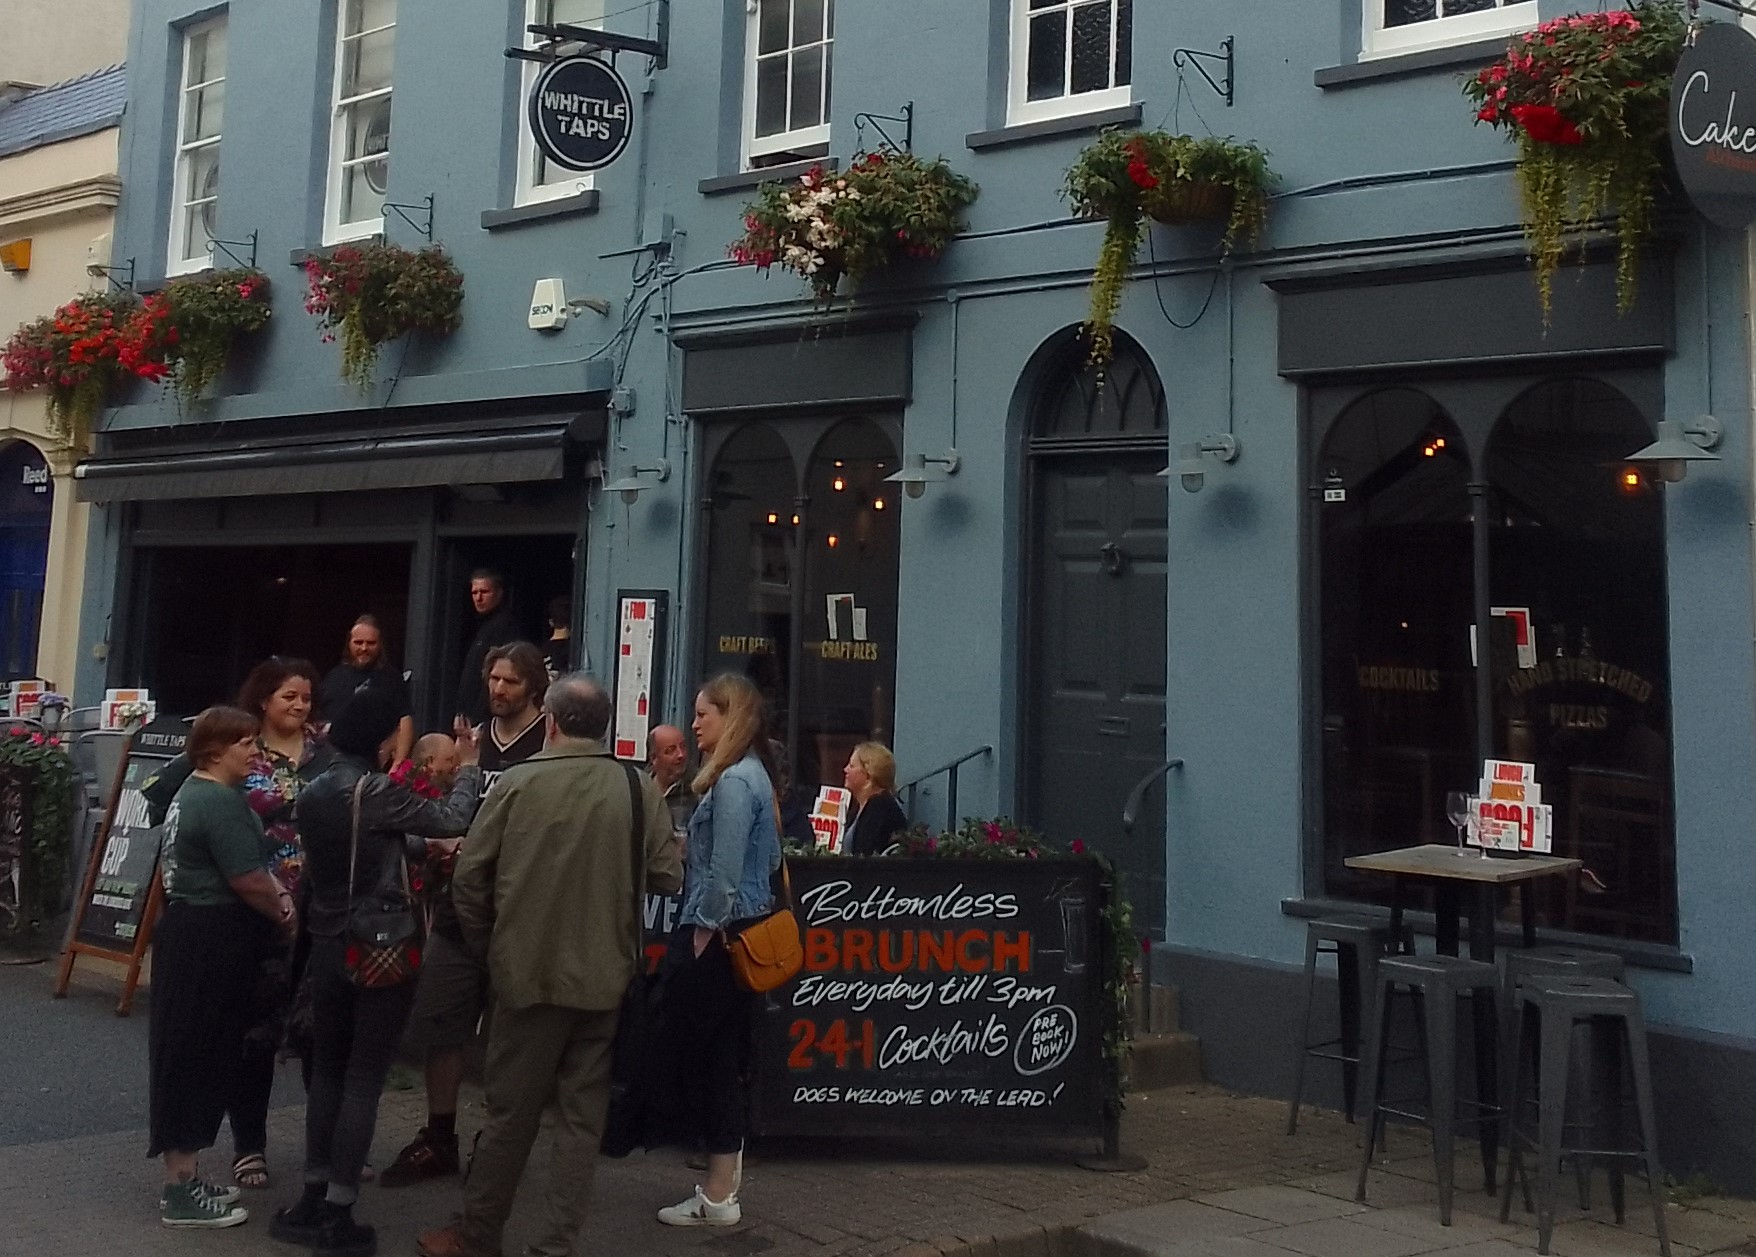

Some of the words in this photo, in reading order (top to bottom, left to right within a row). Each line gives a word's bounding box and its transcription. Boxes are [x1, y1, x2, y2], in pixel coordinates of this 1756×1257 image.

[544, 90, 625, 120] WHITTLE
[557, 114, 610, 140] TAPS
[719, 635, 747, 653] CRAFT
[821, 640, 850, 660] CRAFT
[852, 642, 878, 661] ALES
[1359, 664, 1441, 692] COCKTAILS
[1550, 703, 1608, 729] PIZZAS
[140, 733, 168, 746] WHITTLE
[114, 788, 151, 829] WORL
[101, 836, 130, 876] CUP
[800, 880, 1019, 926] Bottomless
[803, 928, 1030, 973] BRUNCH
[792, 974, 934, 1012] Everyday
[939, 975, 988, 1005] till
[986, 977, 1058, 1010] 3pm
[1031, 1025, 1064, 1046] BOOK
[1033, 1012, 1058, 1032] PRE
[878, 1014, 1008, 1070] Cocktails
[793, 1086, 839, 1103] DOGS
[844, 1088, 923, 1106] WELCOME
[929, 1089, 957, 1106] ON
[959, 1089, 993, 1107] THE
